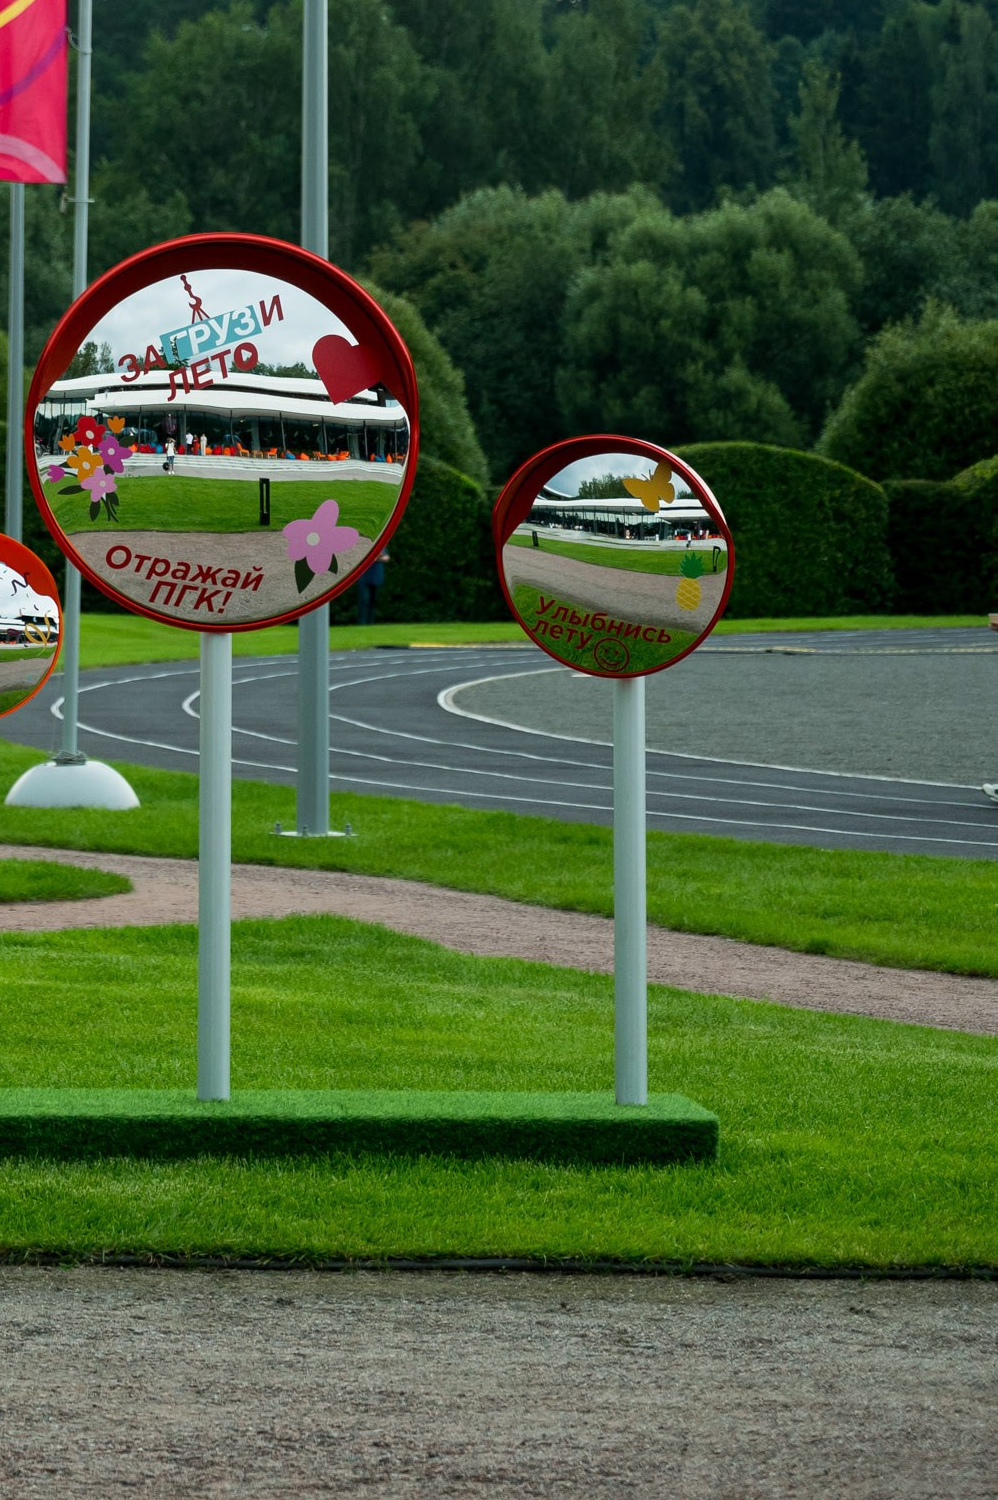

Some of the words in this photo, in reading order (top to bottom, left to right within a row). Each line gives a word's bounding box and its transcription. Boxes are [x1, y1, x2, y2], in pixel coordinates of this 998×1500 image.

[118, 294, 284, 382] ЗАГРУЗИ
[167, 341, 259, 402] ЛЕТО
[105, 544, 265, 592] Отражай
[148, 580, 233, 614] ПГК!
[535, 595, 672, 643] Улыбнись
[531, 619, 593, 649] лету
